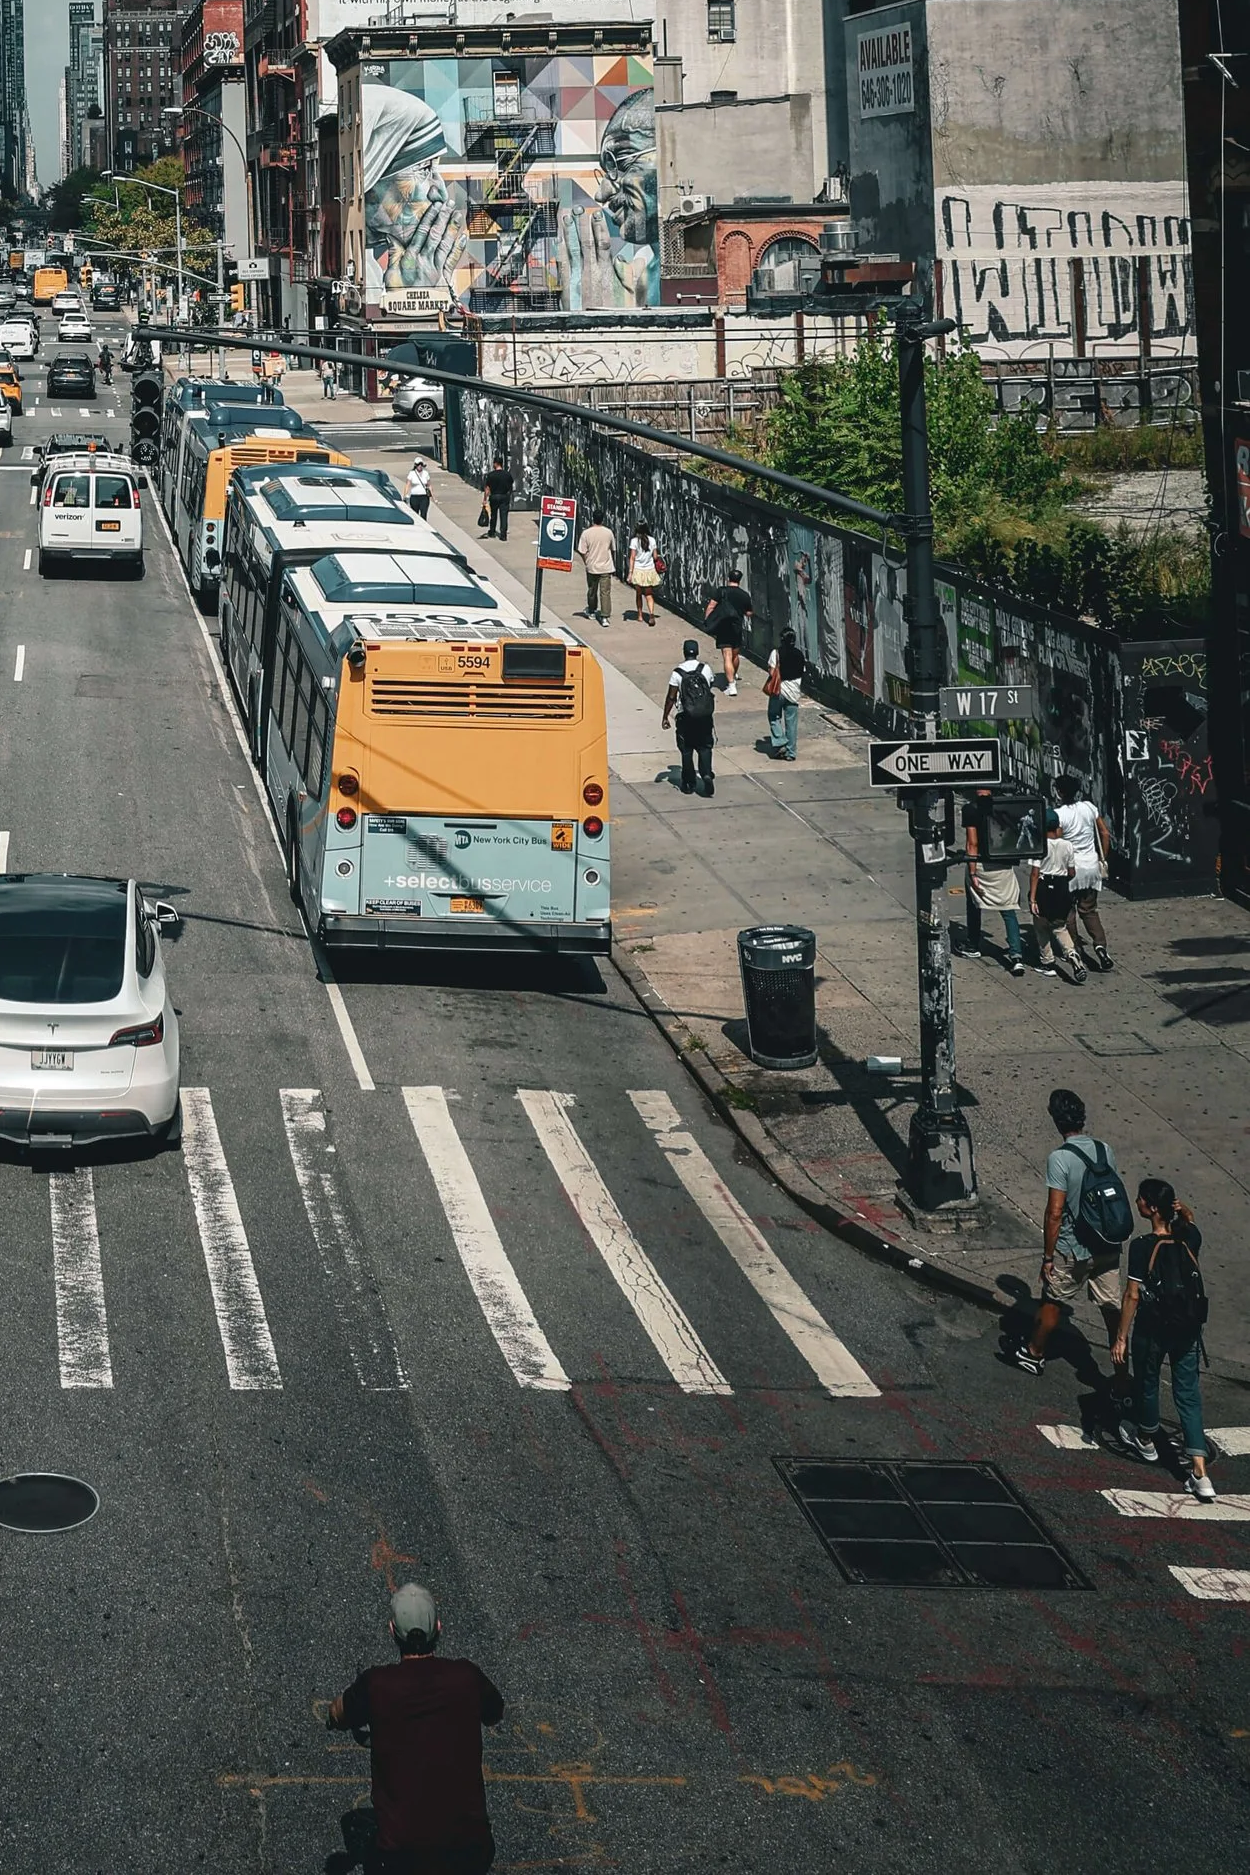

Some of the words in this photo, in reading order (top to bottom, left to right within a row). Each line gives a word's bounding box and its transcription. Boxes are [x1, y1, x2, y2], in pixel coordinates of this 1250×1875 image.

[859, 30, 911, 72] AVAILABLE
[861, 71, 911, 110] 646-306-1020
[406, 291, 430, 300] CHELSEA
[388, 301, 417, 312] SQUARE
[418, 300, 449, 311] MARKET
[546, 503, 571, 512] STANDING
[54, 512, 83, 521] verizon
[343, 613, 505, 628] 5594
[457, 656, 491, 669] 5594
[956, 692, 972, 716] W
[978, 692, 998, 716] 17
[1007, 690, 1019, 704] St
[895, 755, 930, 772] ONE
[947, 753, 985, 770] WAY
[454, 834, 471, 844] MTA
[473, 836, 491, 844] New
[492, 836, 511, 844] York
[512, 836, 530, 846] City
[532, 837, 547, 845] Bus
[781, 953, 803, 964] NYC
